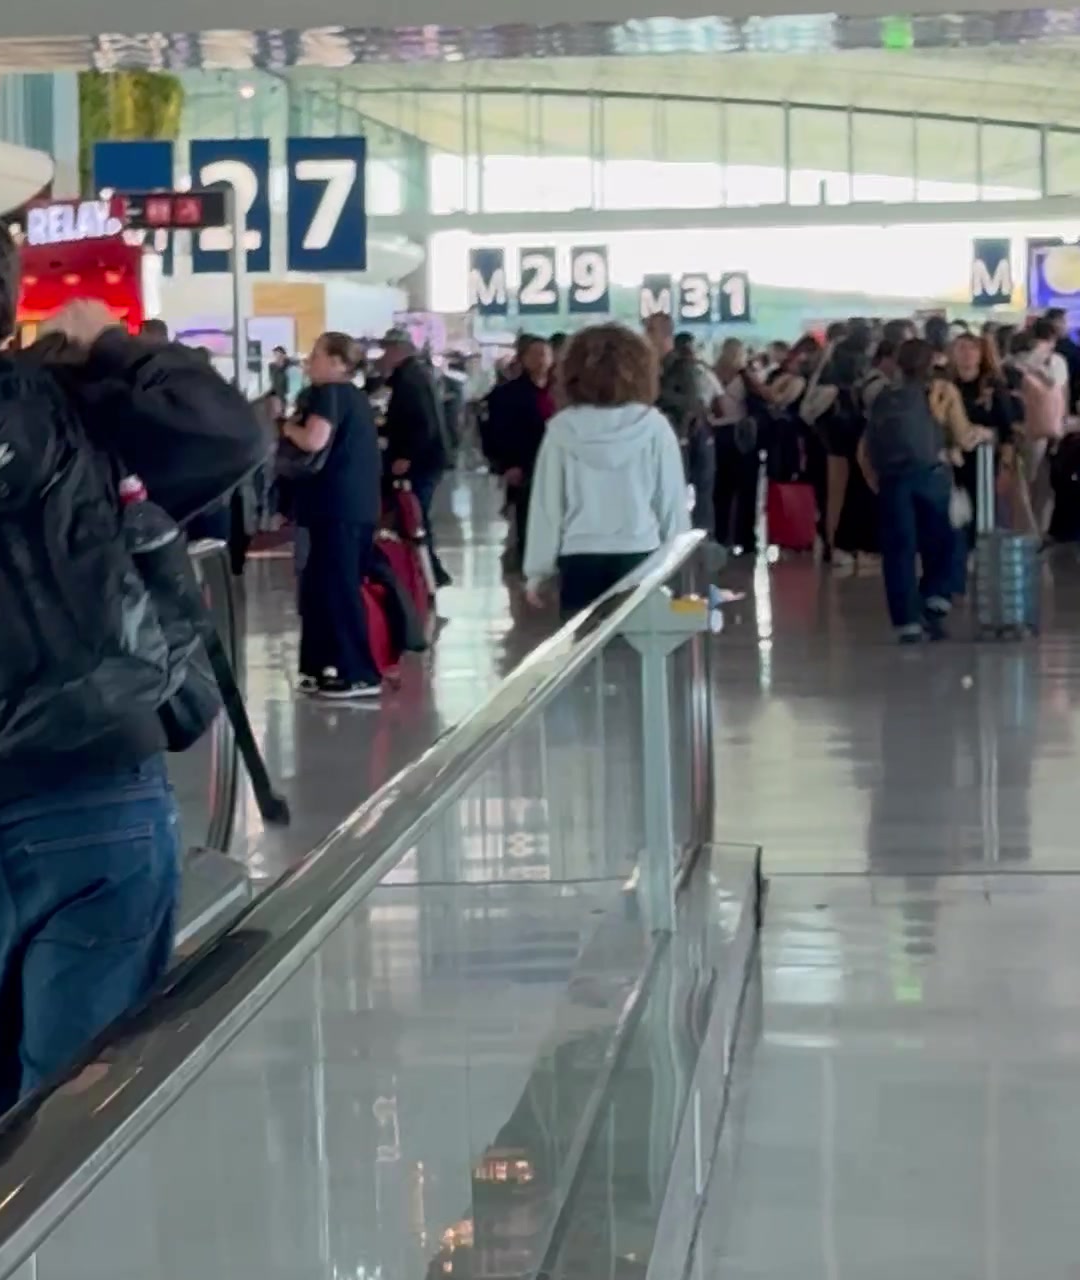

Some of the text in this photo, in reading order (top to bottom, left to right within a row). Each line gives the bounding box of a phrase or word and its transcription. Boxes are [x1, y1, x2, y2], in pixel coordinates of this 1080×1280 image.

[469, 251, 608, 305] M29
[640, 275, 746, 318] M31
[972, 258, 1011, 297] M
